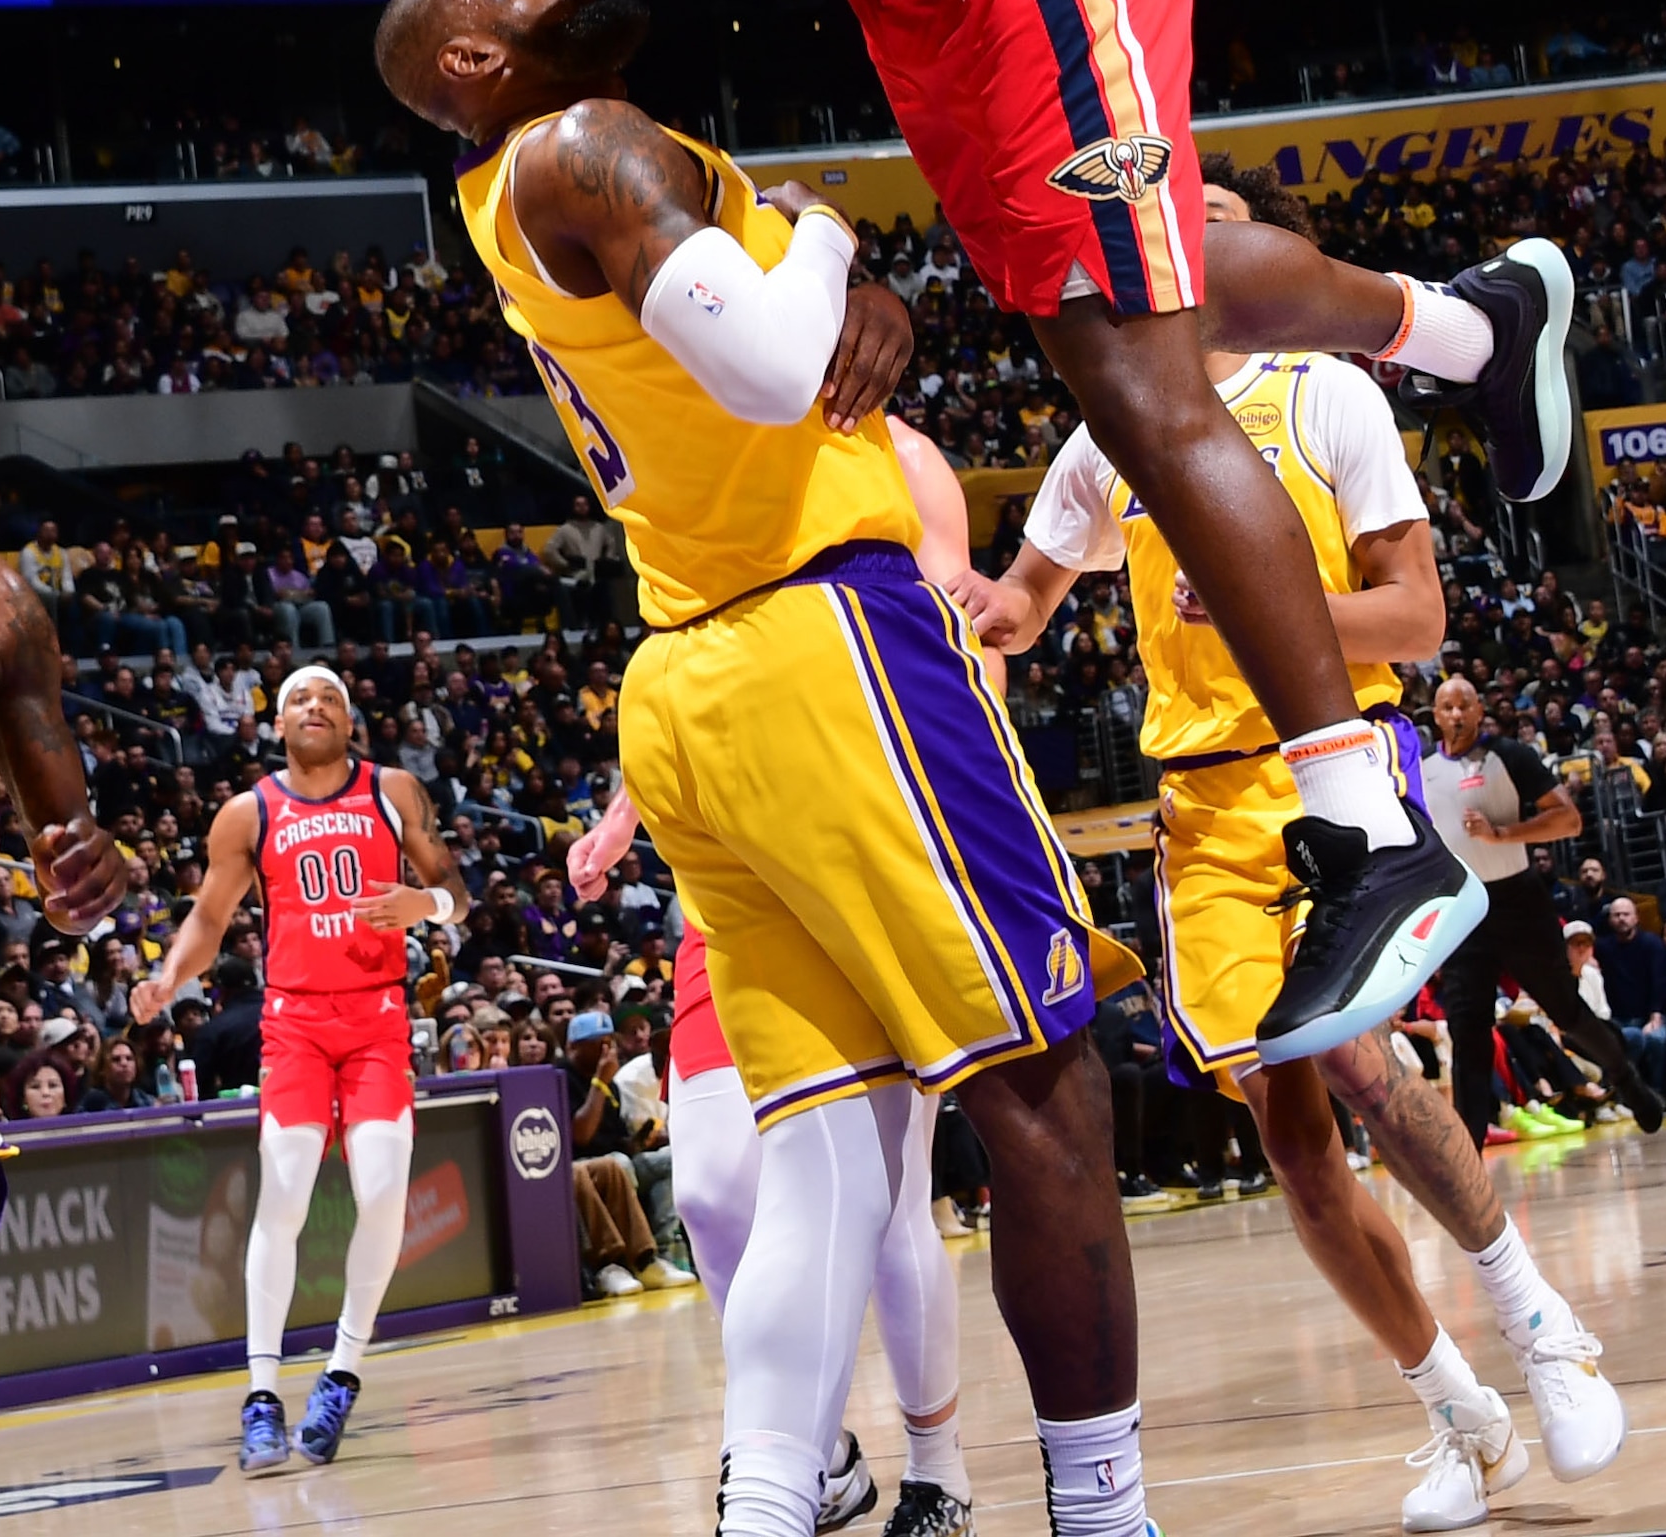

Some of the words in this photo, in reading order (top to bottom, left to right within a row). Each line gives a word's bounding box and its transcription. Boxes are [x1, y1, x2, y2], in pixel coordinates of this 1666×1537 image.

[1271, 101, 1653, 186] ANGELES
[1239, 412, 1278, 426] bibigo
[274, 812, 374, 854] CRESCENT
[296, 845, 362, 905] 00
[311, 910, 356, 938] CITY
